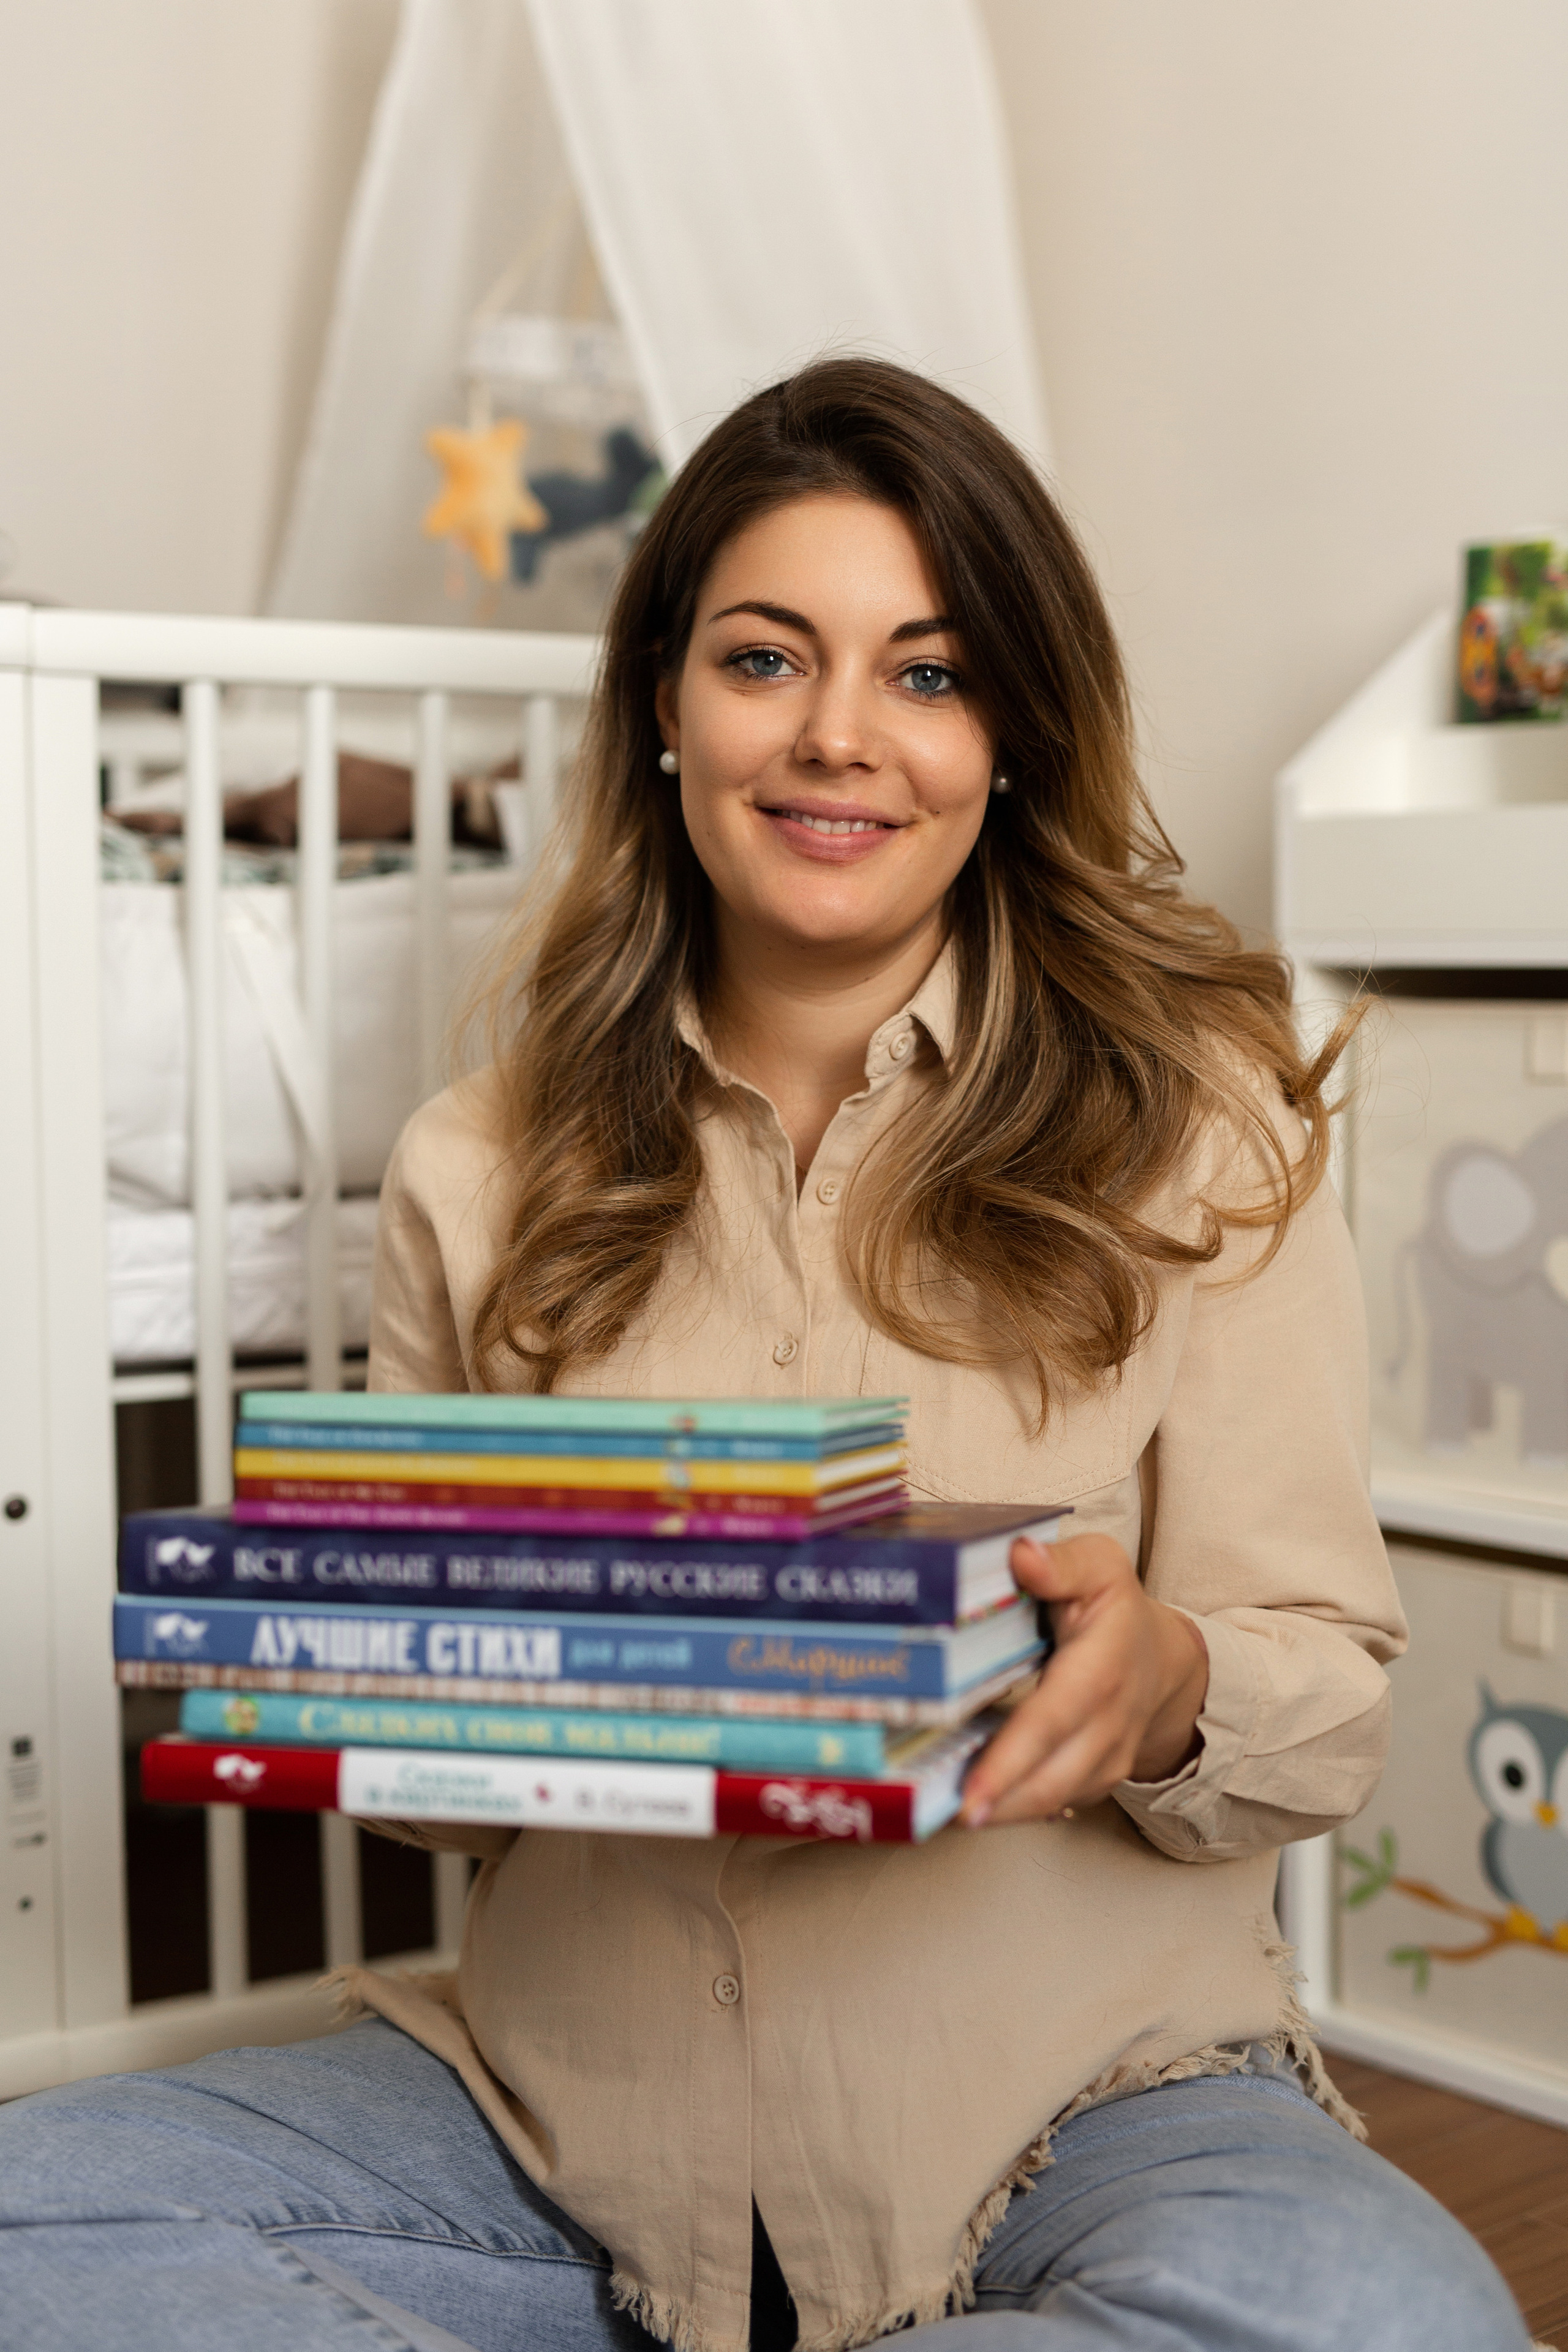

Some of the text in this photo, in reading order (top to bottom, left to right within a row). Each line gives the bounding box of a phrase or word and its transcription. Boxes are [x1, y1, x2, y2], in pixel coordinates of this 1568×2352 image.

[233, 1547, 918, 1605] ВСЕ САМЫЕ ВЕЛИКИЕ РУССКИЕ СКАЗКИ
[252, 1615, 419, 1673] ЛУЧШИЕ
[426, 1623, 561, 1677] СТИХИ
